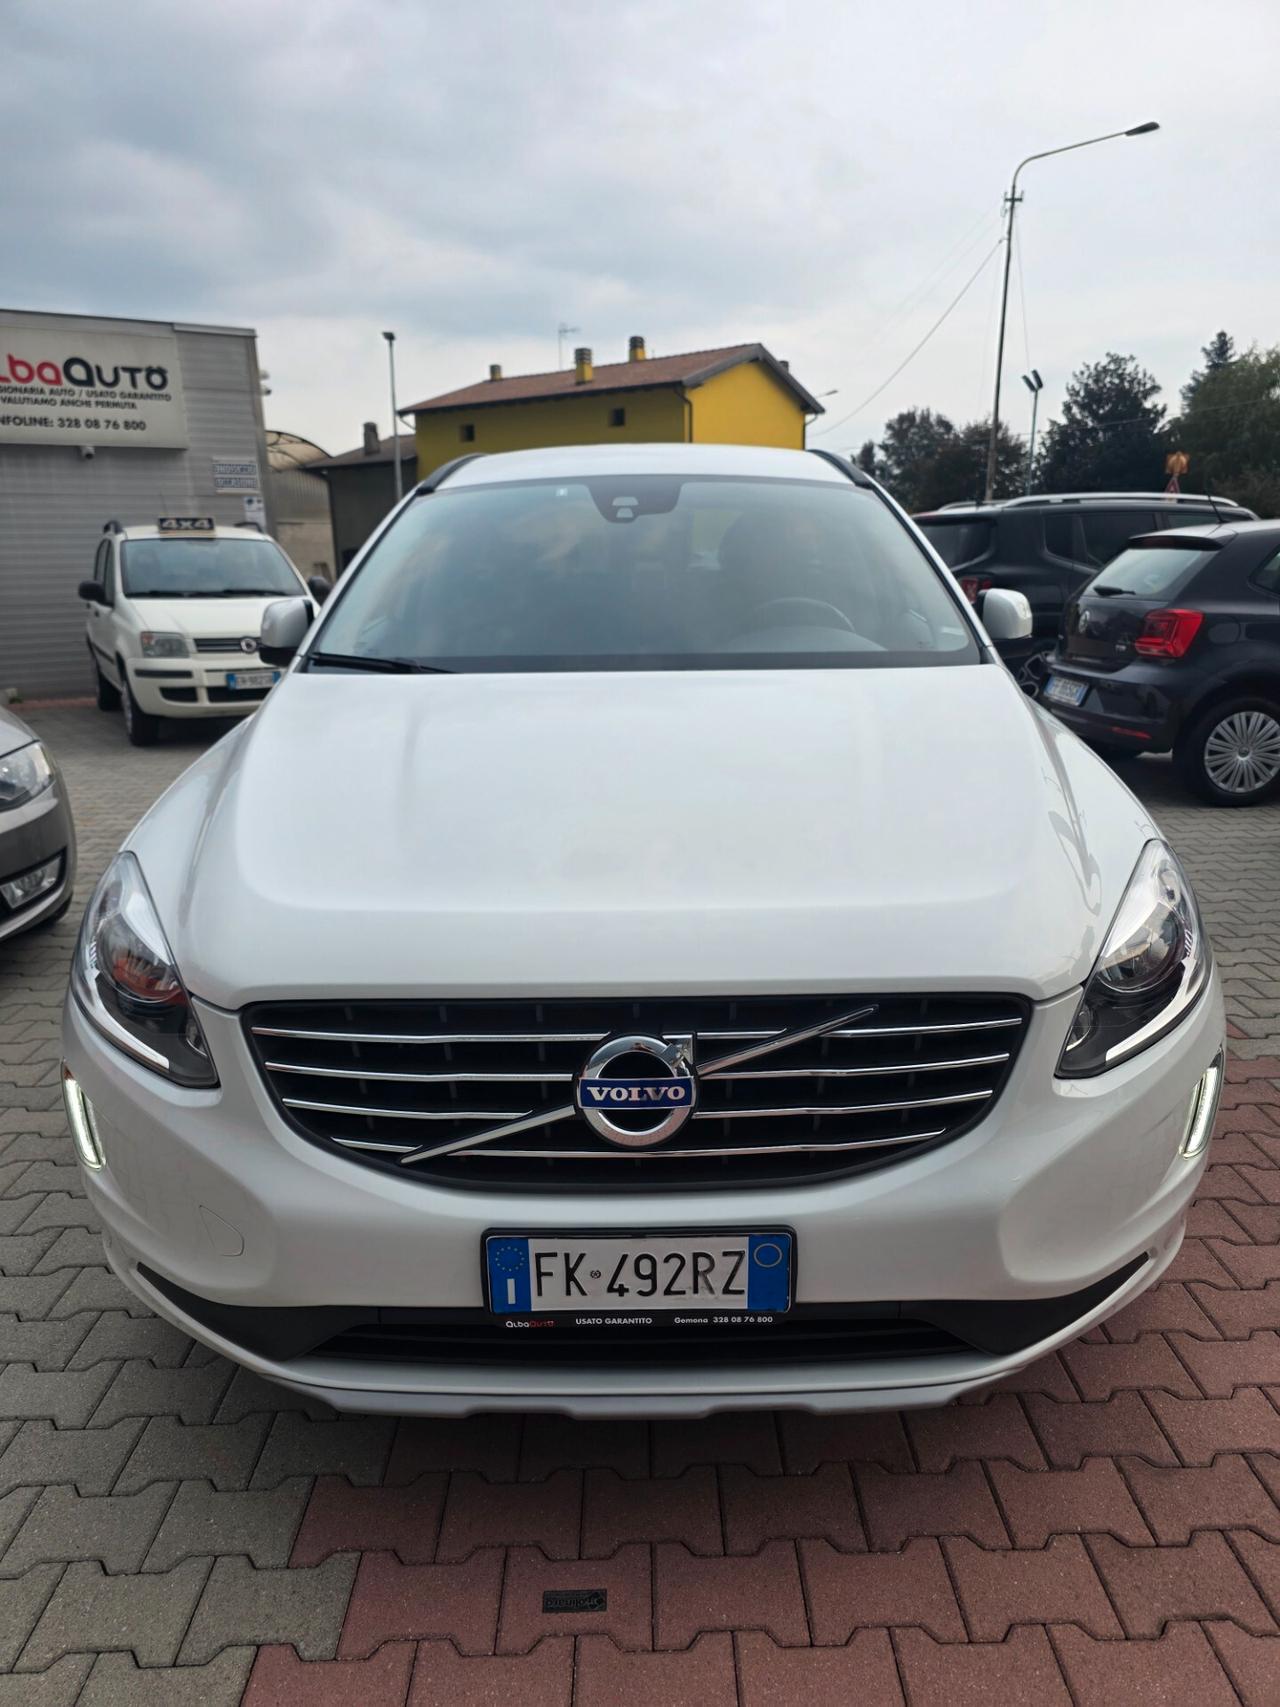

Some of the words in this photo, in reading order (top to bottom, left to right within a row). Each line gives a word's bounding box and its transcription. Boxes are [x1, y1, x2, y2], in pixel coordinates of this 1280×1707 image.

[49, 388, 75, 397] AUTO
[86, 389, 117, 399] USATO
[119, 391, 171, 401] GARANTITO
[1, 396, 57, 407] VALUTIAMO
[60, 398, 92, 408] ANCHE
[95, 400, 137, 410] PERMUTA
[57, 417, 81, 428] 328
[85, 419, 101, 429] 08
[104, 420, 120, 430] 76
[123, 420, 146, 431] 800
[162, 519, 209, 530] 4x4
[587, 1086, 686, 1101] VOLVO
[604, 1317, 653, 1325] GARANTITO
